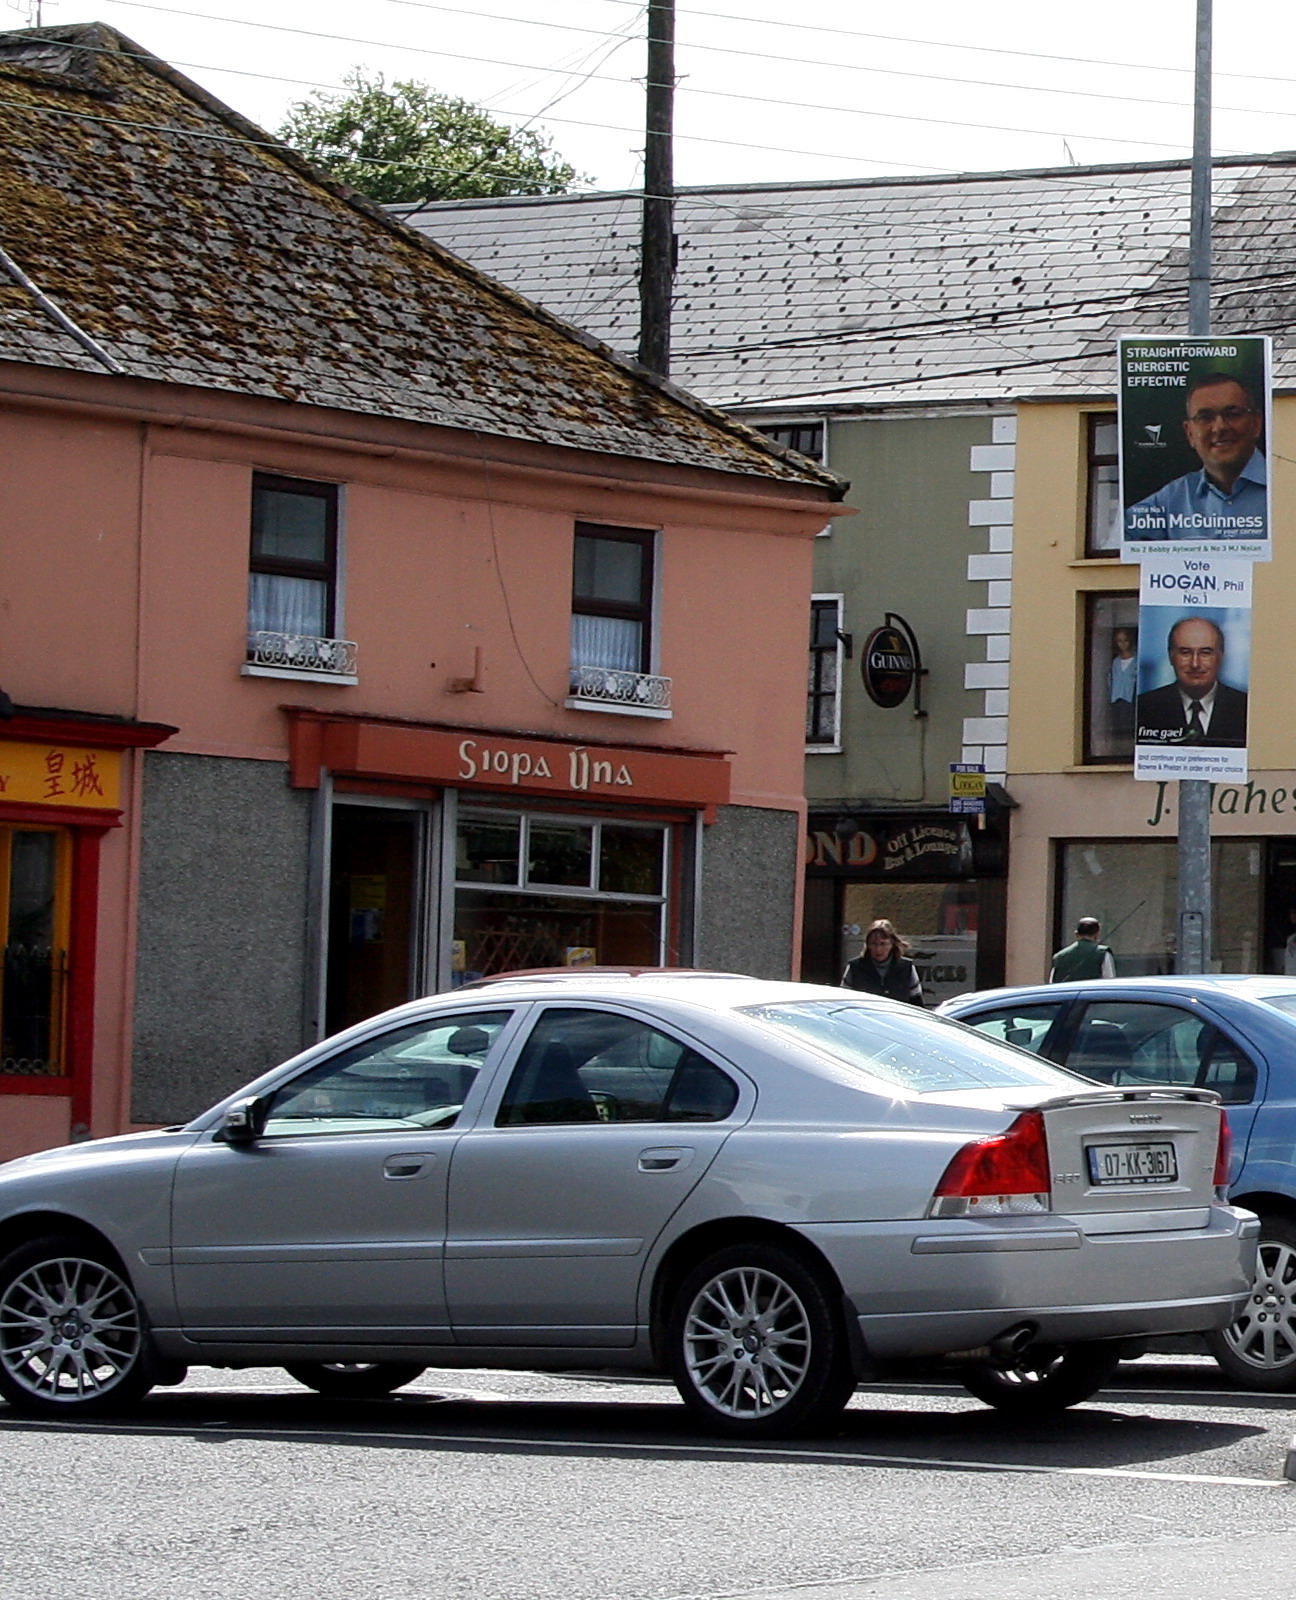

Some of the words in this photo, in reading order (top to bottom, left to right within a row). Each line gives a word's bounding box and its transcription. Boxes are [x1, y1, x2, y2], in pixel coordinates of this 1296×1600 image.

[1126, 346, 1237, 358] STRAIGHTFORWARD
[1127, 361, 1190, 373] ENERGETIC
[1127, 375, 1187, 387] EFFECTIVE
[1127, 514, 1166, 529] John
[1169, 513, 1263, 529] McGuinness
[1183, 560, 1210, 571] Vote
[1150, 573, 1220, 592] HOGAN,
[1223, 580, 1244, 591] Phil
[1138, 726, 1159, 736] fine
[1160, 727, 1183, 739] gael
[458, 740, 552, 784] Siopa
[569, 746, 633, 790] Úna
[1147, 781, 1171, 826] J.
[1104, 1151, 1170, 1176] 07-KK-3167
